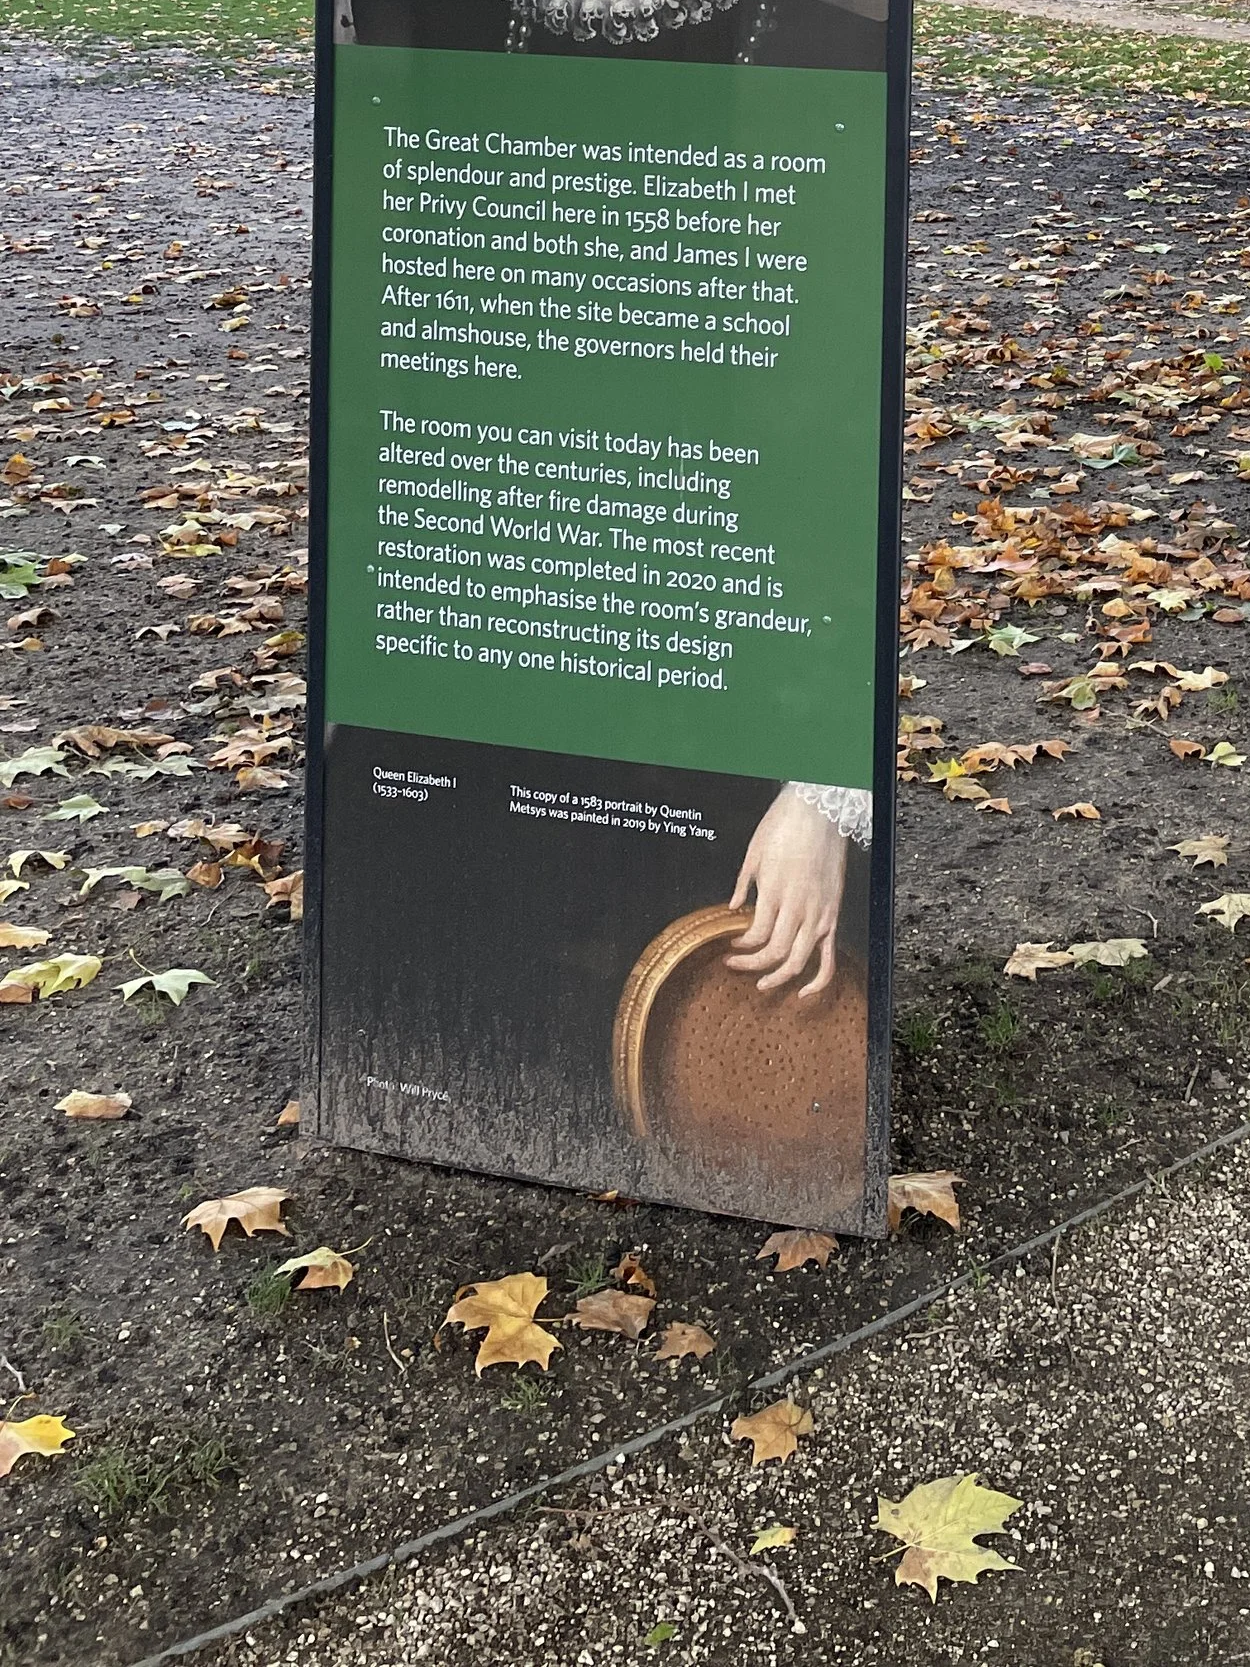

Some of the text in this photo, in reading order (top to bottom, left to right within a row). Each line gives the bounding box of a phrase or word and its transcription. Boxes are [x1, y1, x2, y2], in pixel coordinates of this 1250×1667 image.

[383, 126, 826, 174] The Great Chamber was intended as a room
[382, 158, 797, 206] of splendour and prestige. Elizabeth I met
[382, 188, 782, 237] her Privy Council here in 1558 before her
[379, 409, 759, 465] The room you can visit today has been
[378, 441, 732, 500] altered over the centuries, including
[378, 477, 739, 533] remodelling after fire damage during
[372, 766, 457, 789] Queen Elizabeth I
[372, 781, 429, 802] (1533-1603)
[509, 784, 702, 821] This copy of a 1583 portrait by Quentin
[509, 800, 717, 841] Metsys was painted in 2019 by Ying Yang.
[400, 1082, 420, 1096] Will
